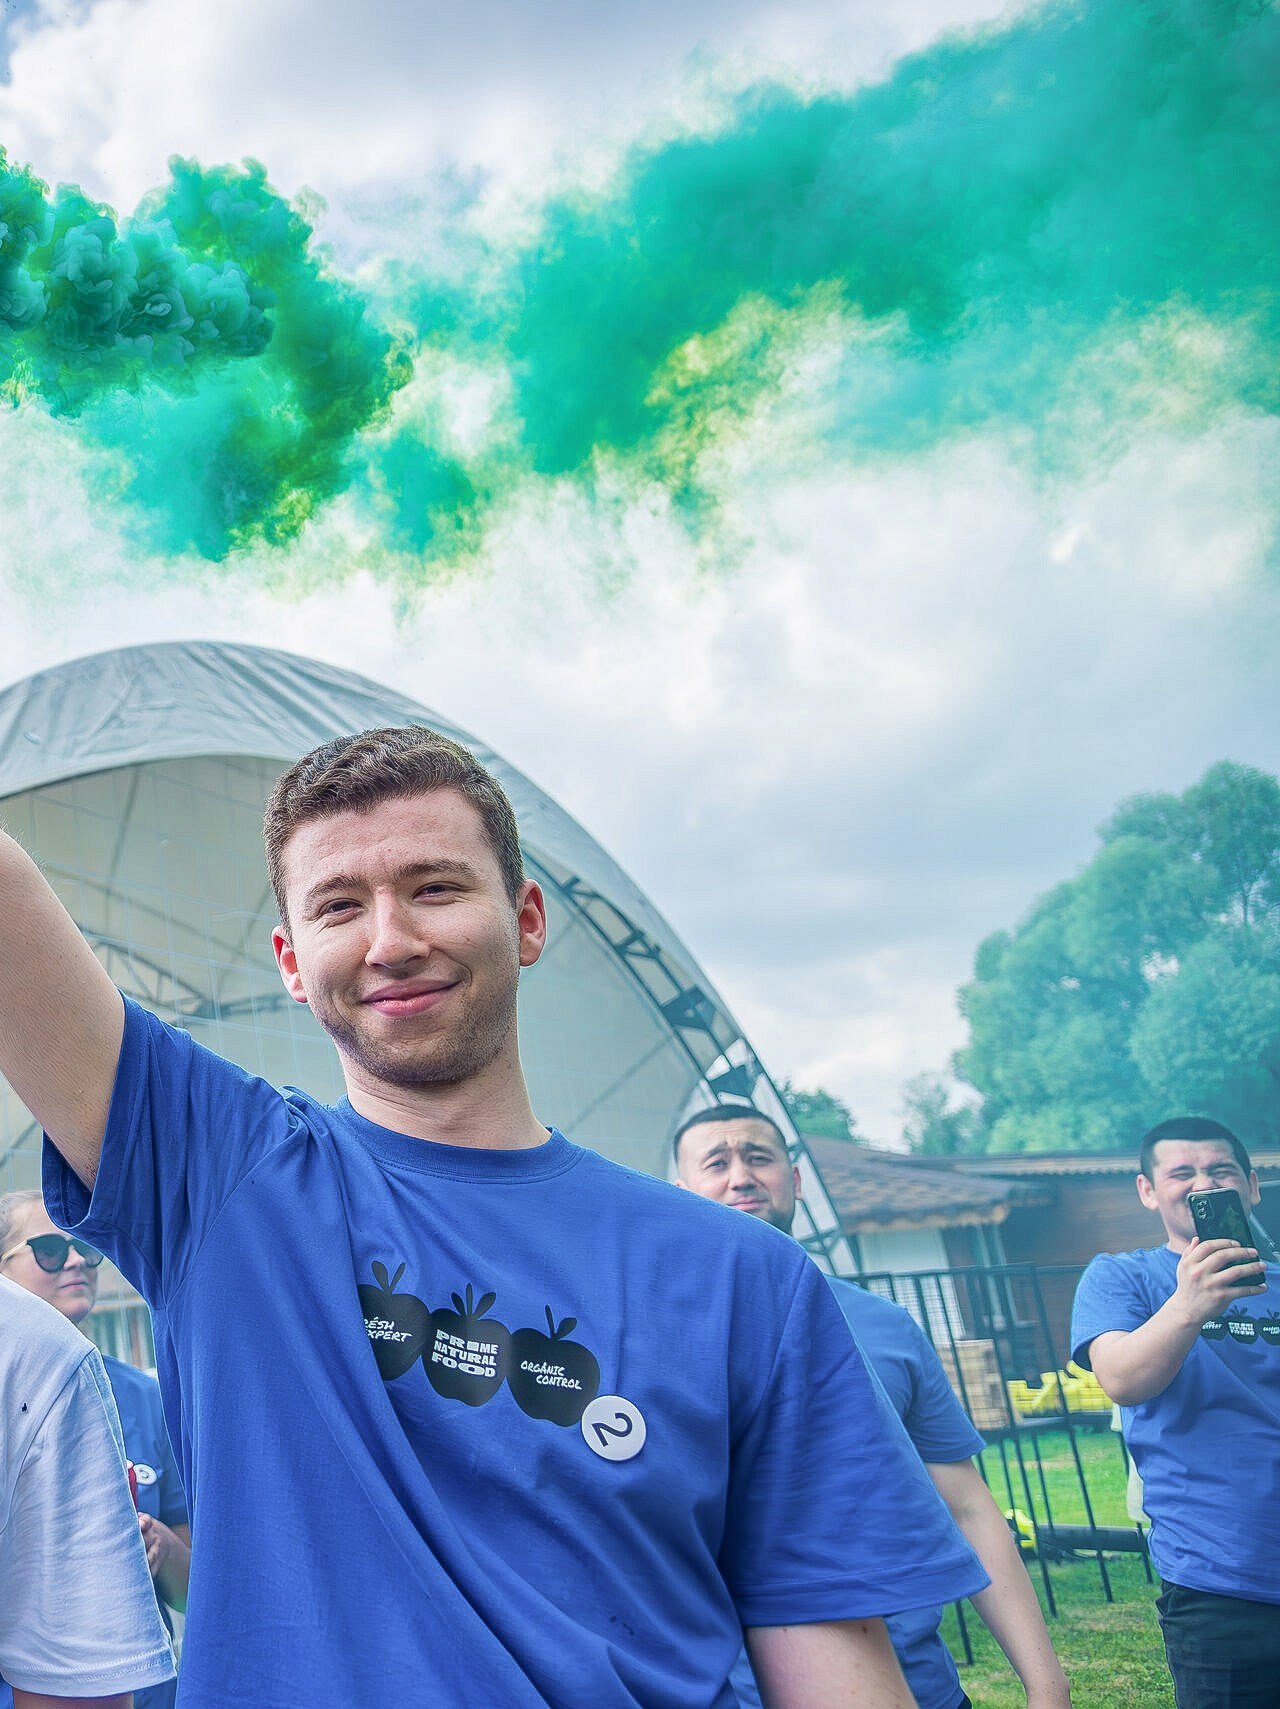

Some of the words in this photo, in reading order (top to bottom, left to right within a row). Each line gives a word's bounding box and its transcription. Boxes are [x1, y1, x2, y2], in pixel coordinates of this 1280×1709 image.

[365, 1329, 413, 1342] XPERT
[432, 1352, 497, 1377] FOOD
[434, 1340, 498, 1367] NATURAL
[536, 1374, 583, 1390] CONTROL
[591, 1412, 633, 1447] 2
